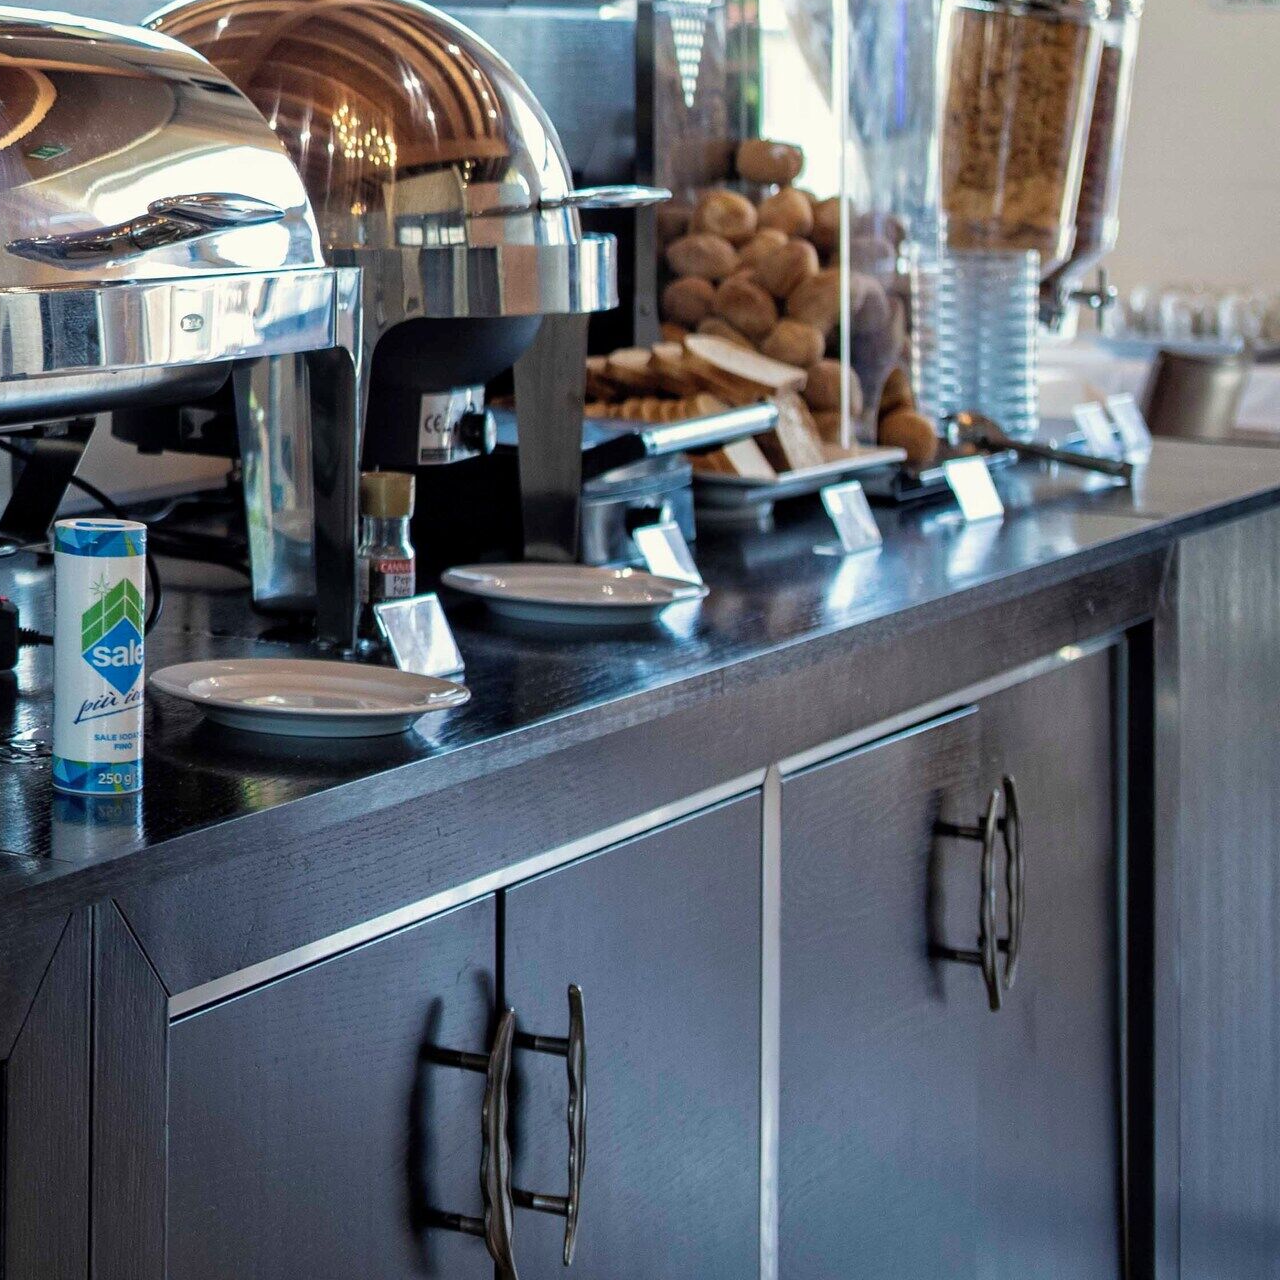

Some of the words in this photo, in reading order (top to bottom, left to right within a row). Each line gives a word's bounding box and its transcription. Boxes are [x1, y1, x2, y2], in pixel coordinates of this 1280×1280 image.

[92, 638, 144, 668] sale
[74, 691, 119, 725] più
[94, 733, 118, 742] SALE
[113, 742, 133, 751] FINO
[98, 773, 122, 785] 250
[124, 774, 132, 786] g
